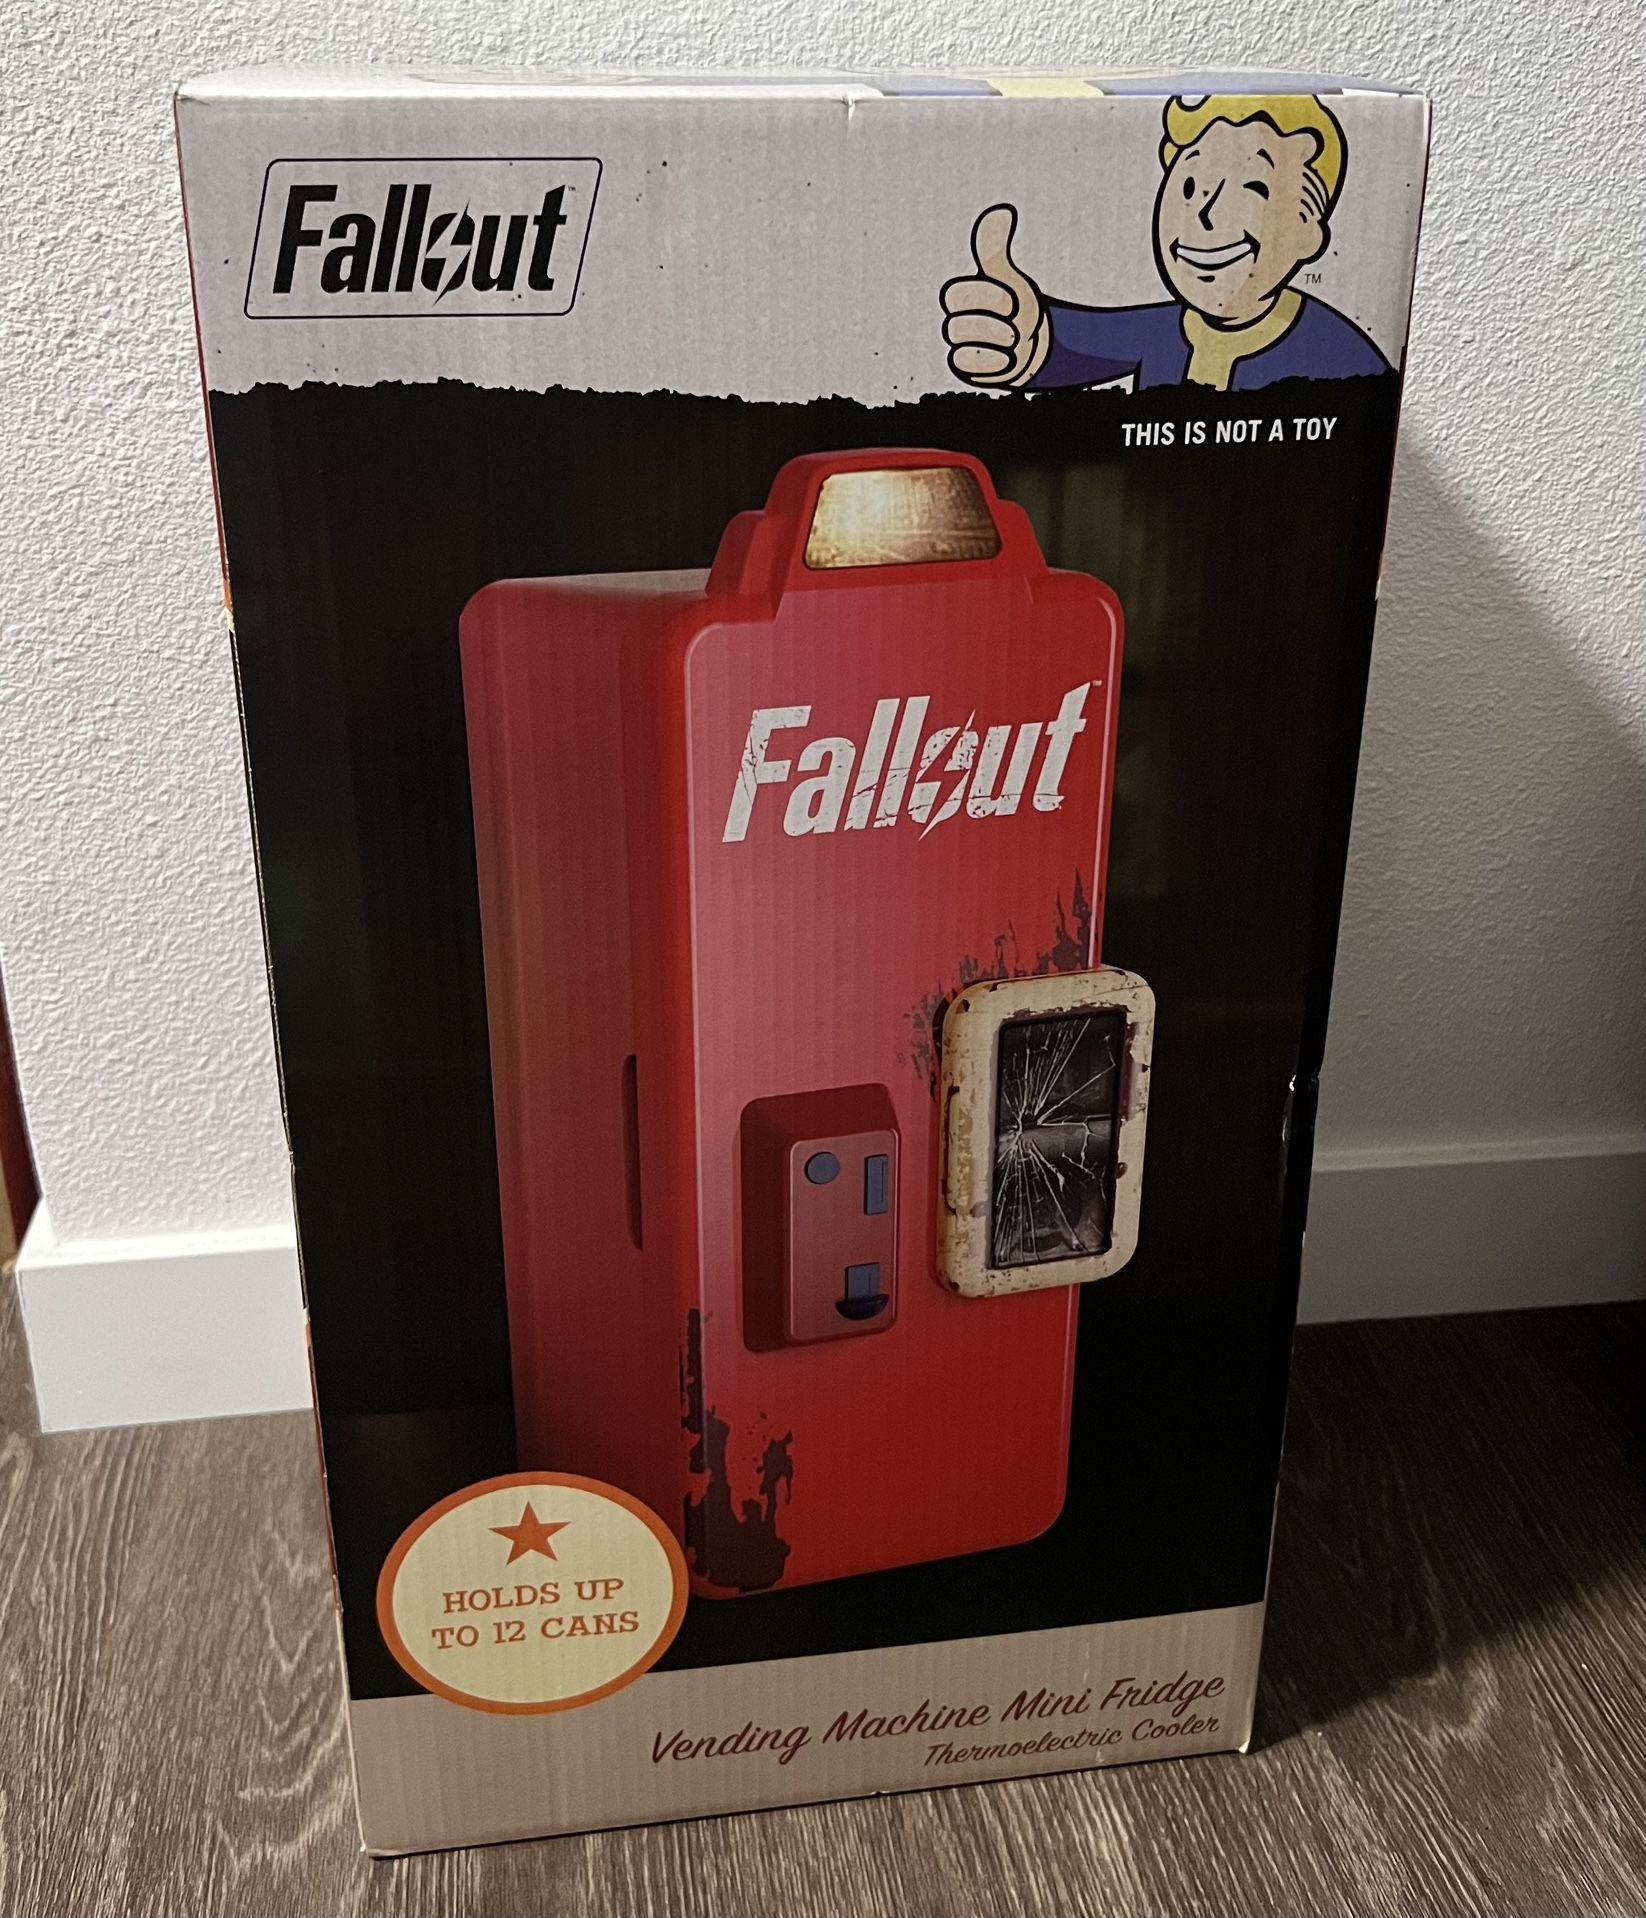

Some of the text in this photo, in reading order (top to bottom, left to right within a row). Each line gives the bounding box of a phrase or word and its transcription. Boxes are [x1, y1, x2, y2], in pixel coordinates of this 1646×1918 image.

[273, 184, 568, 305] Fallout
[1304, 273, 1321, 284] TM
[1121, 417, 1338, 447] THIS IS NOT A TOY
[722, 682, 1091, 843] Fallout
[442, 1577, 625, 1615] HOLDS UP
[431, 1611, 640, 1650] TO 12 CANS
[650, 1670, 1226, 1765] Vending Machine Mini Fridge
[922, 1715, 1220, 1767] Thermoelectric Cooler
